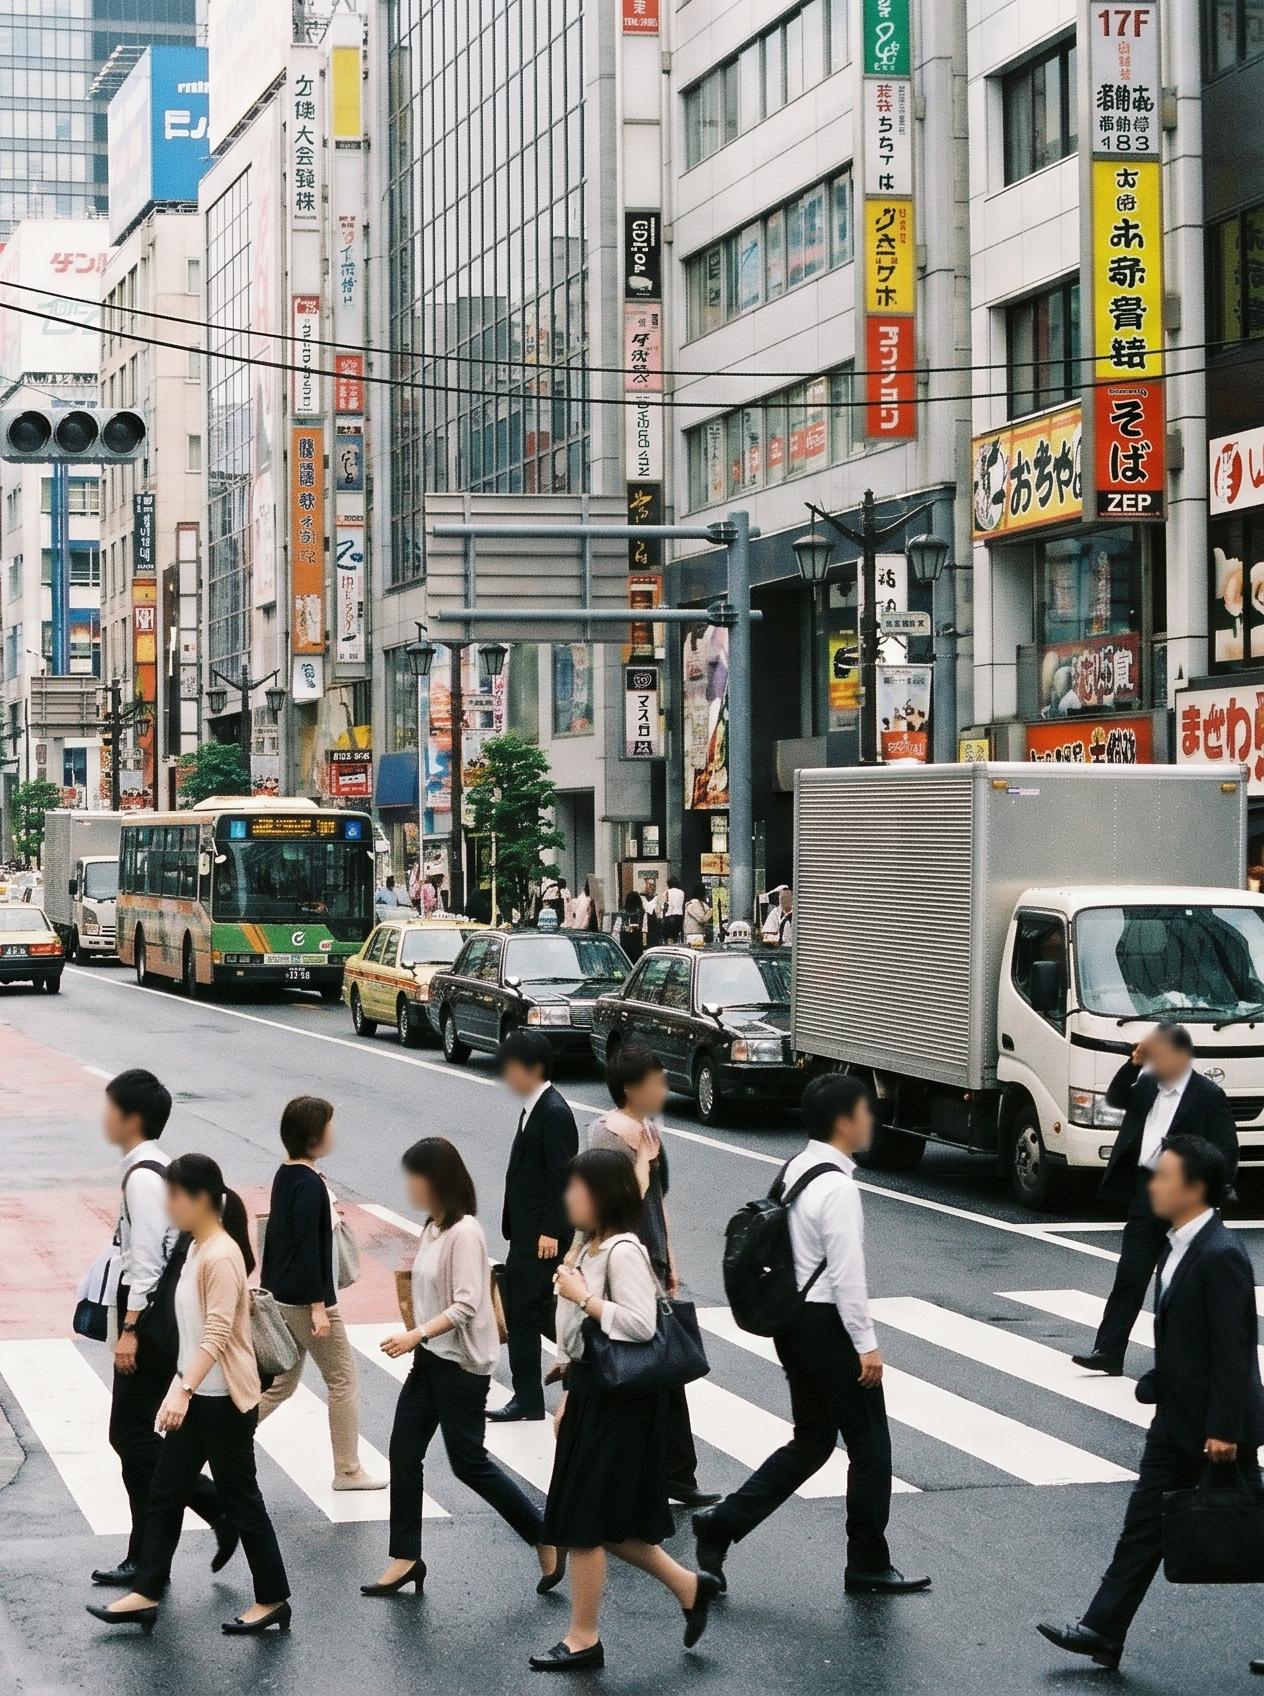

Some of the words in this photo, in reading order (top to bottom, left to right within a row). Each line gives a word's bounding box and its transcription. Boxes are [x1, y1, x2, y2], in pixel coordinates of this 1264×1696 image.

[1098, 9, 1150, 37] 17F
[1110, 399, 1151, 483] そば
[1107, 493, 1151, 512] ZEP
